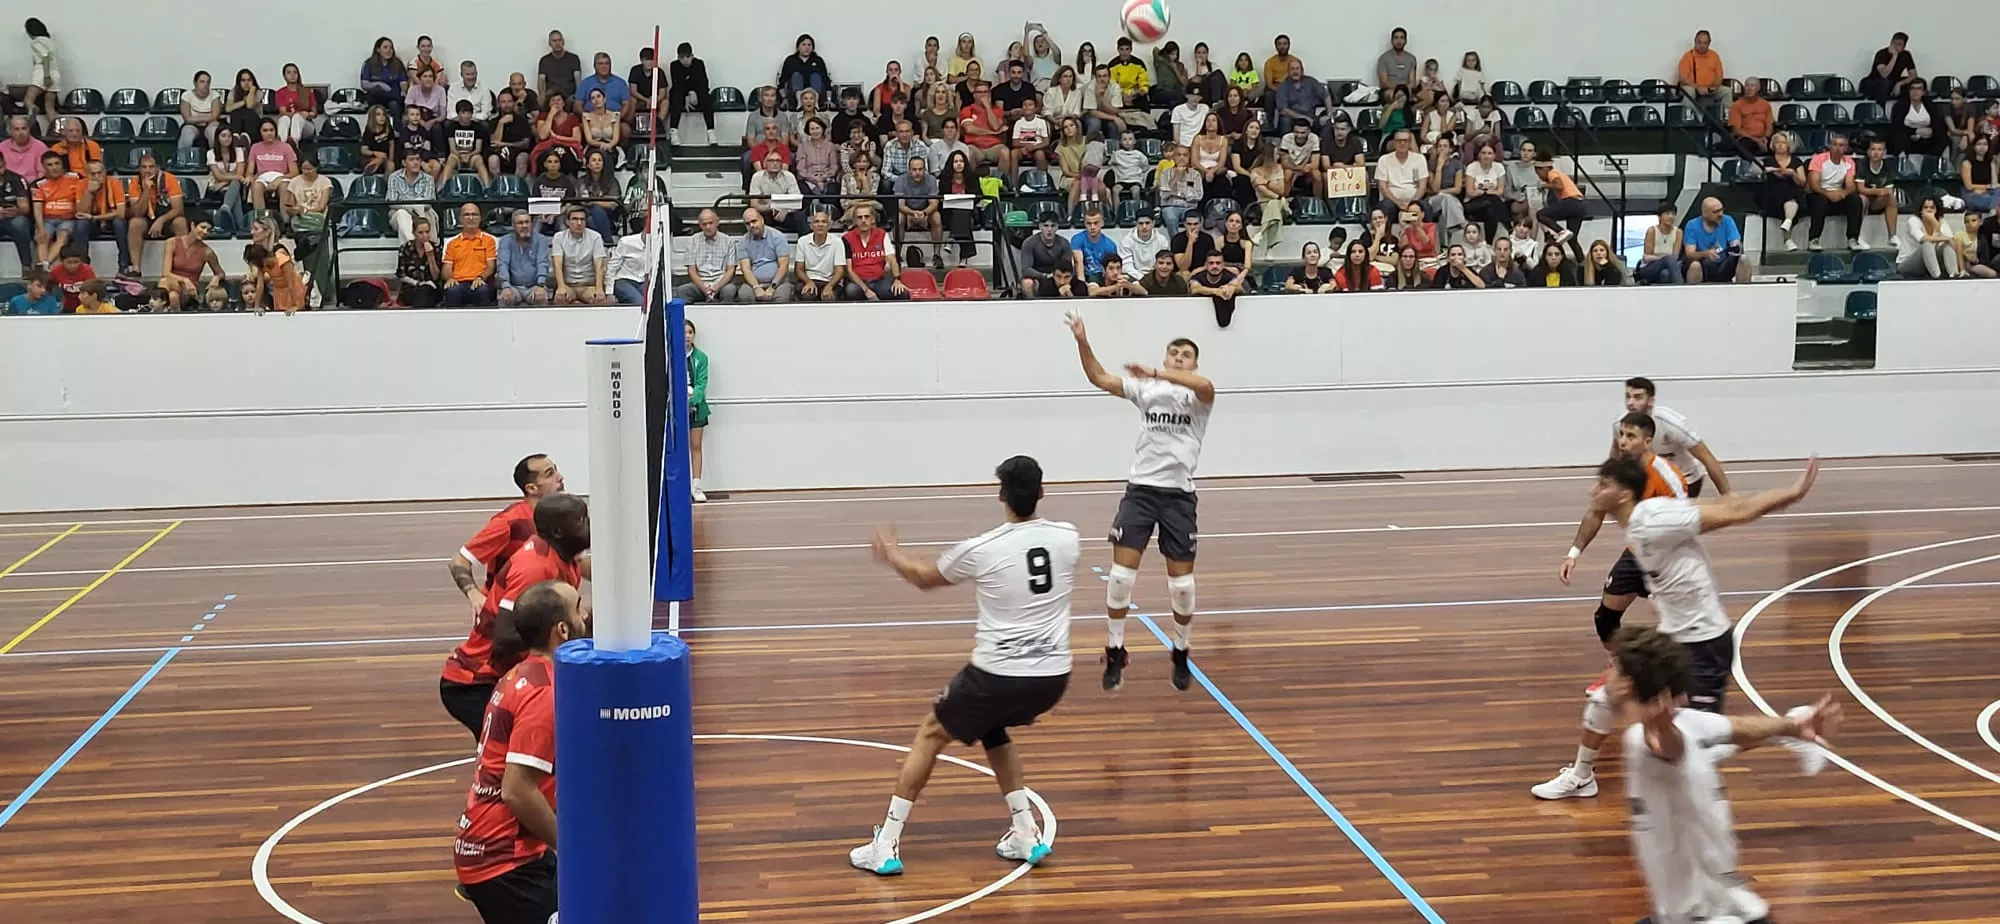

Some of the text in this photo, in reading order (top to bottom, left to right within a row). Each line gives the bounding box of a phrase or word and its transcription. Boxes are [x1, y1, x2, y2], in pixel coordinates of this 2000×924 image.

[611, 371, 621, 419] MONDO
[1026, 547, 1053, 594] 9
[613, 704, 671, 720] MONDO
